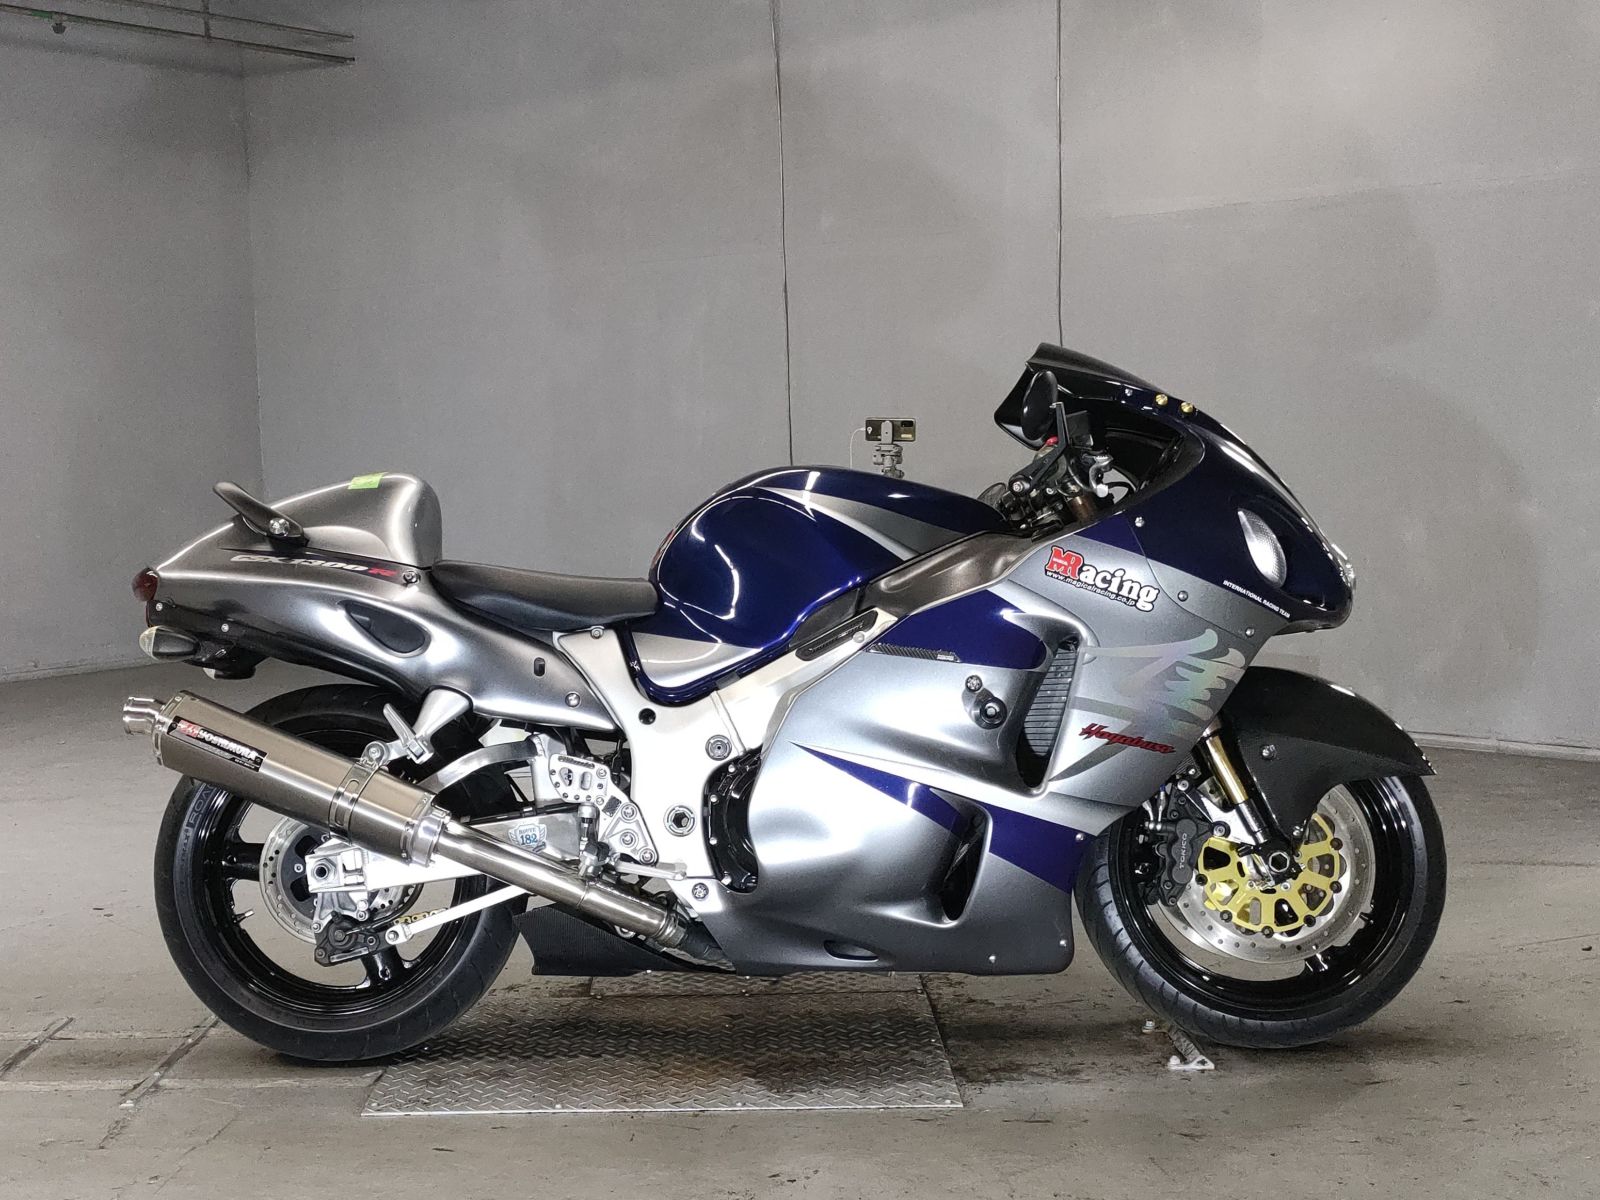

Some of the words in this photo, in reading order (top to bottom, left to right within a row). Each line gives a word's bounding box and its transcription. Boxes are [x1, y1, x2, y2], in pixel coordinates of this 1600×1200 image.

[1222, 579, 1263, 603] INTERNATIONAL
[1262, 599, 1280, 612] RACING
[1279, 608, 1291, 619] TEAM
[519, 833, 538, 846] 182
[1179, 833, 1188, 868] TOKICO
